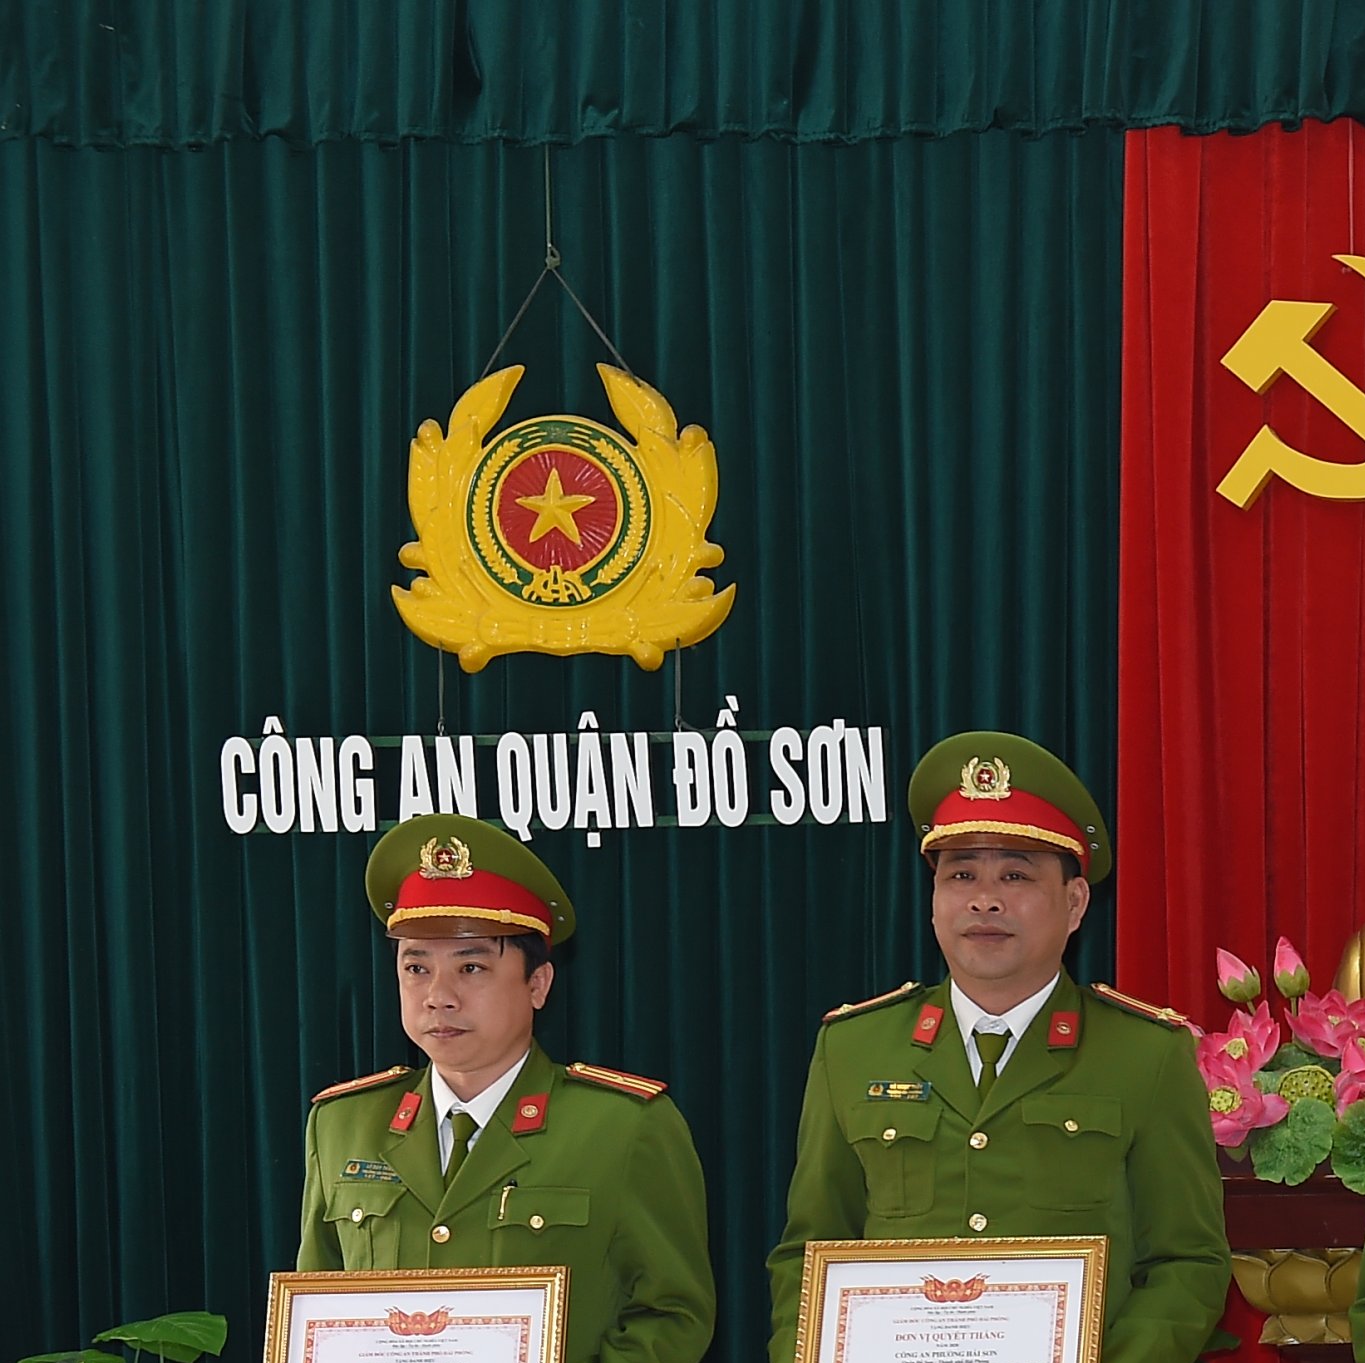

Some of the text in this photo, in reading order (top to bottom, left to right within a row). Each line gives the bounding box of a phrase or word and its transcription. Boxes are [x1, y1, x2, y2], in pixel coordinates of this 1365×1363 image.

[220, 695, 887, 848] CÔNG AN QUẬN ĐỒ SƠN
